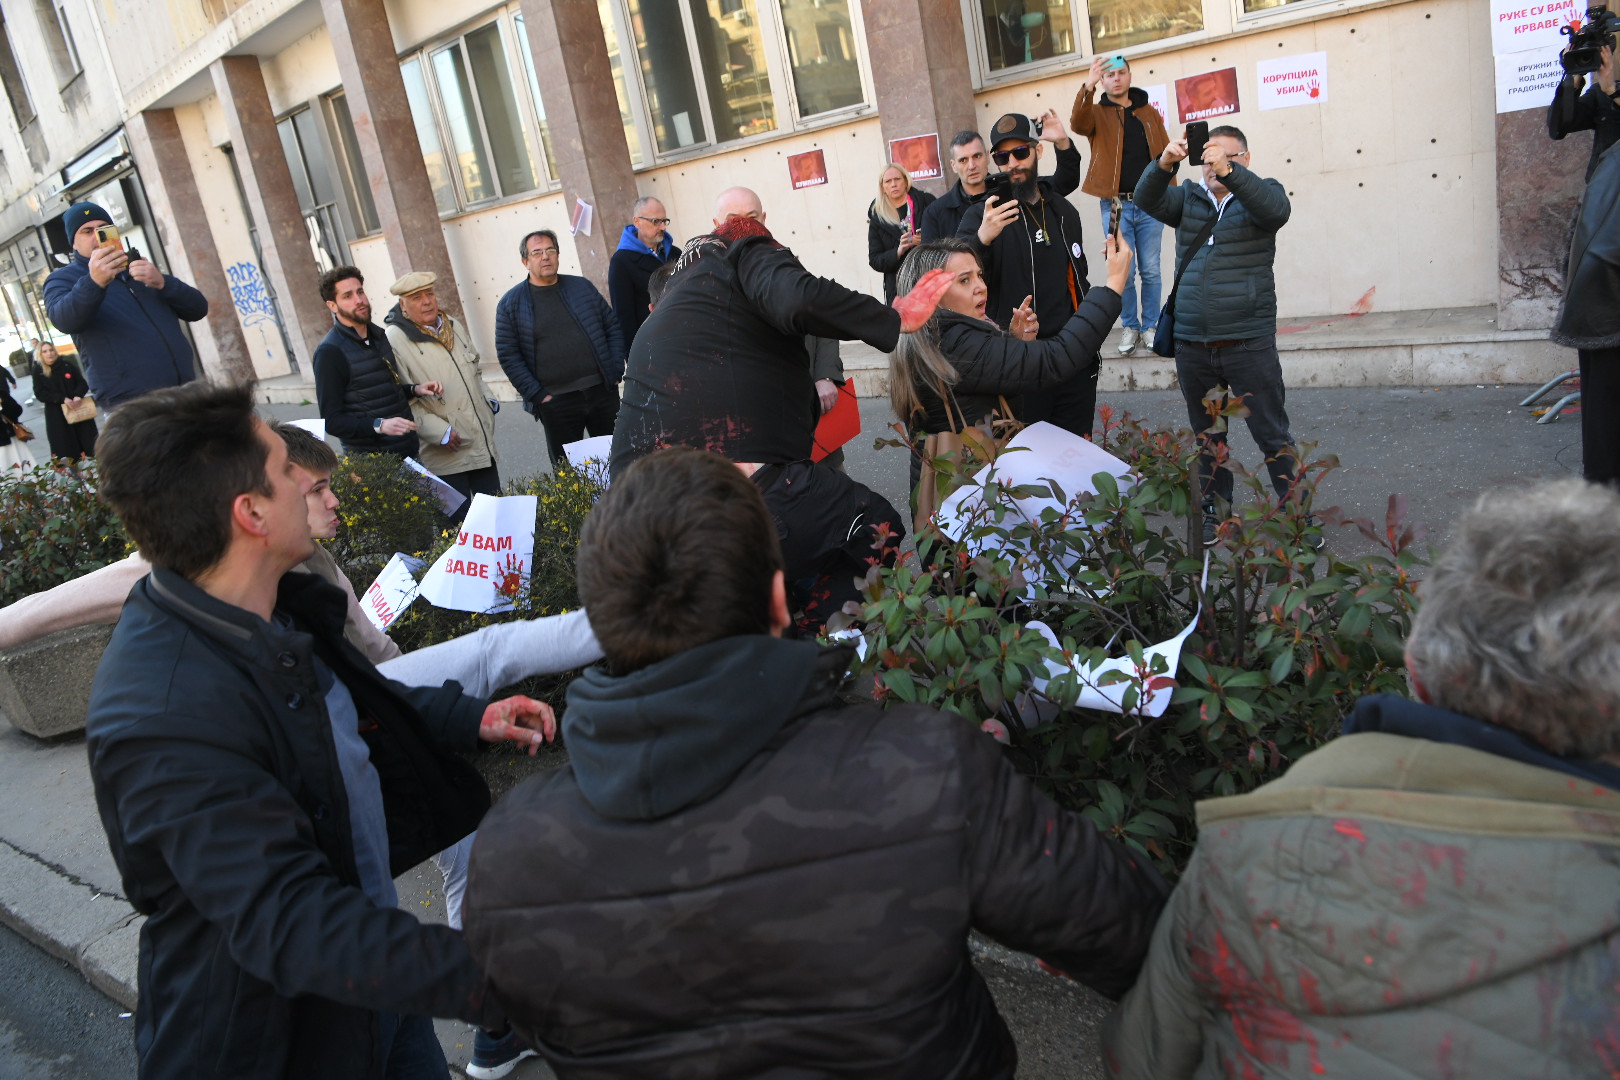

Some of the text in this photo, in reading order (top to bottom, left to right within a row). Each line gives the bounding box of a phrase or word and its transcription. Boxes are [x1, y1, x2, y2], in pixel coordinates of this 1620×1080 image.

[1499, 0, 1574, 23] РУКЕ СУ ВАМ
[1514, 18, 1560, 35] КРВАВЕ
[1518, 61, 1552, 73] КРУЖНИ
[1263, 68, 1319, 84] КОРУПЦИЈА
[1519, 75, 1536, 83] КОД
[1276, 84, 1306, 96] УБИЈА
[1185, 104, 1235, 121] ПУМПАААЈ
[455, 531, 513, 552] У ВАМ
[369, 580, 395, 628] ПЦИЈА
